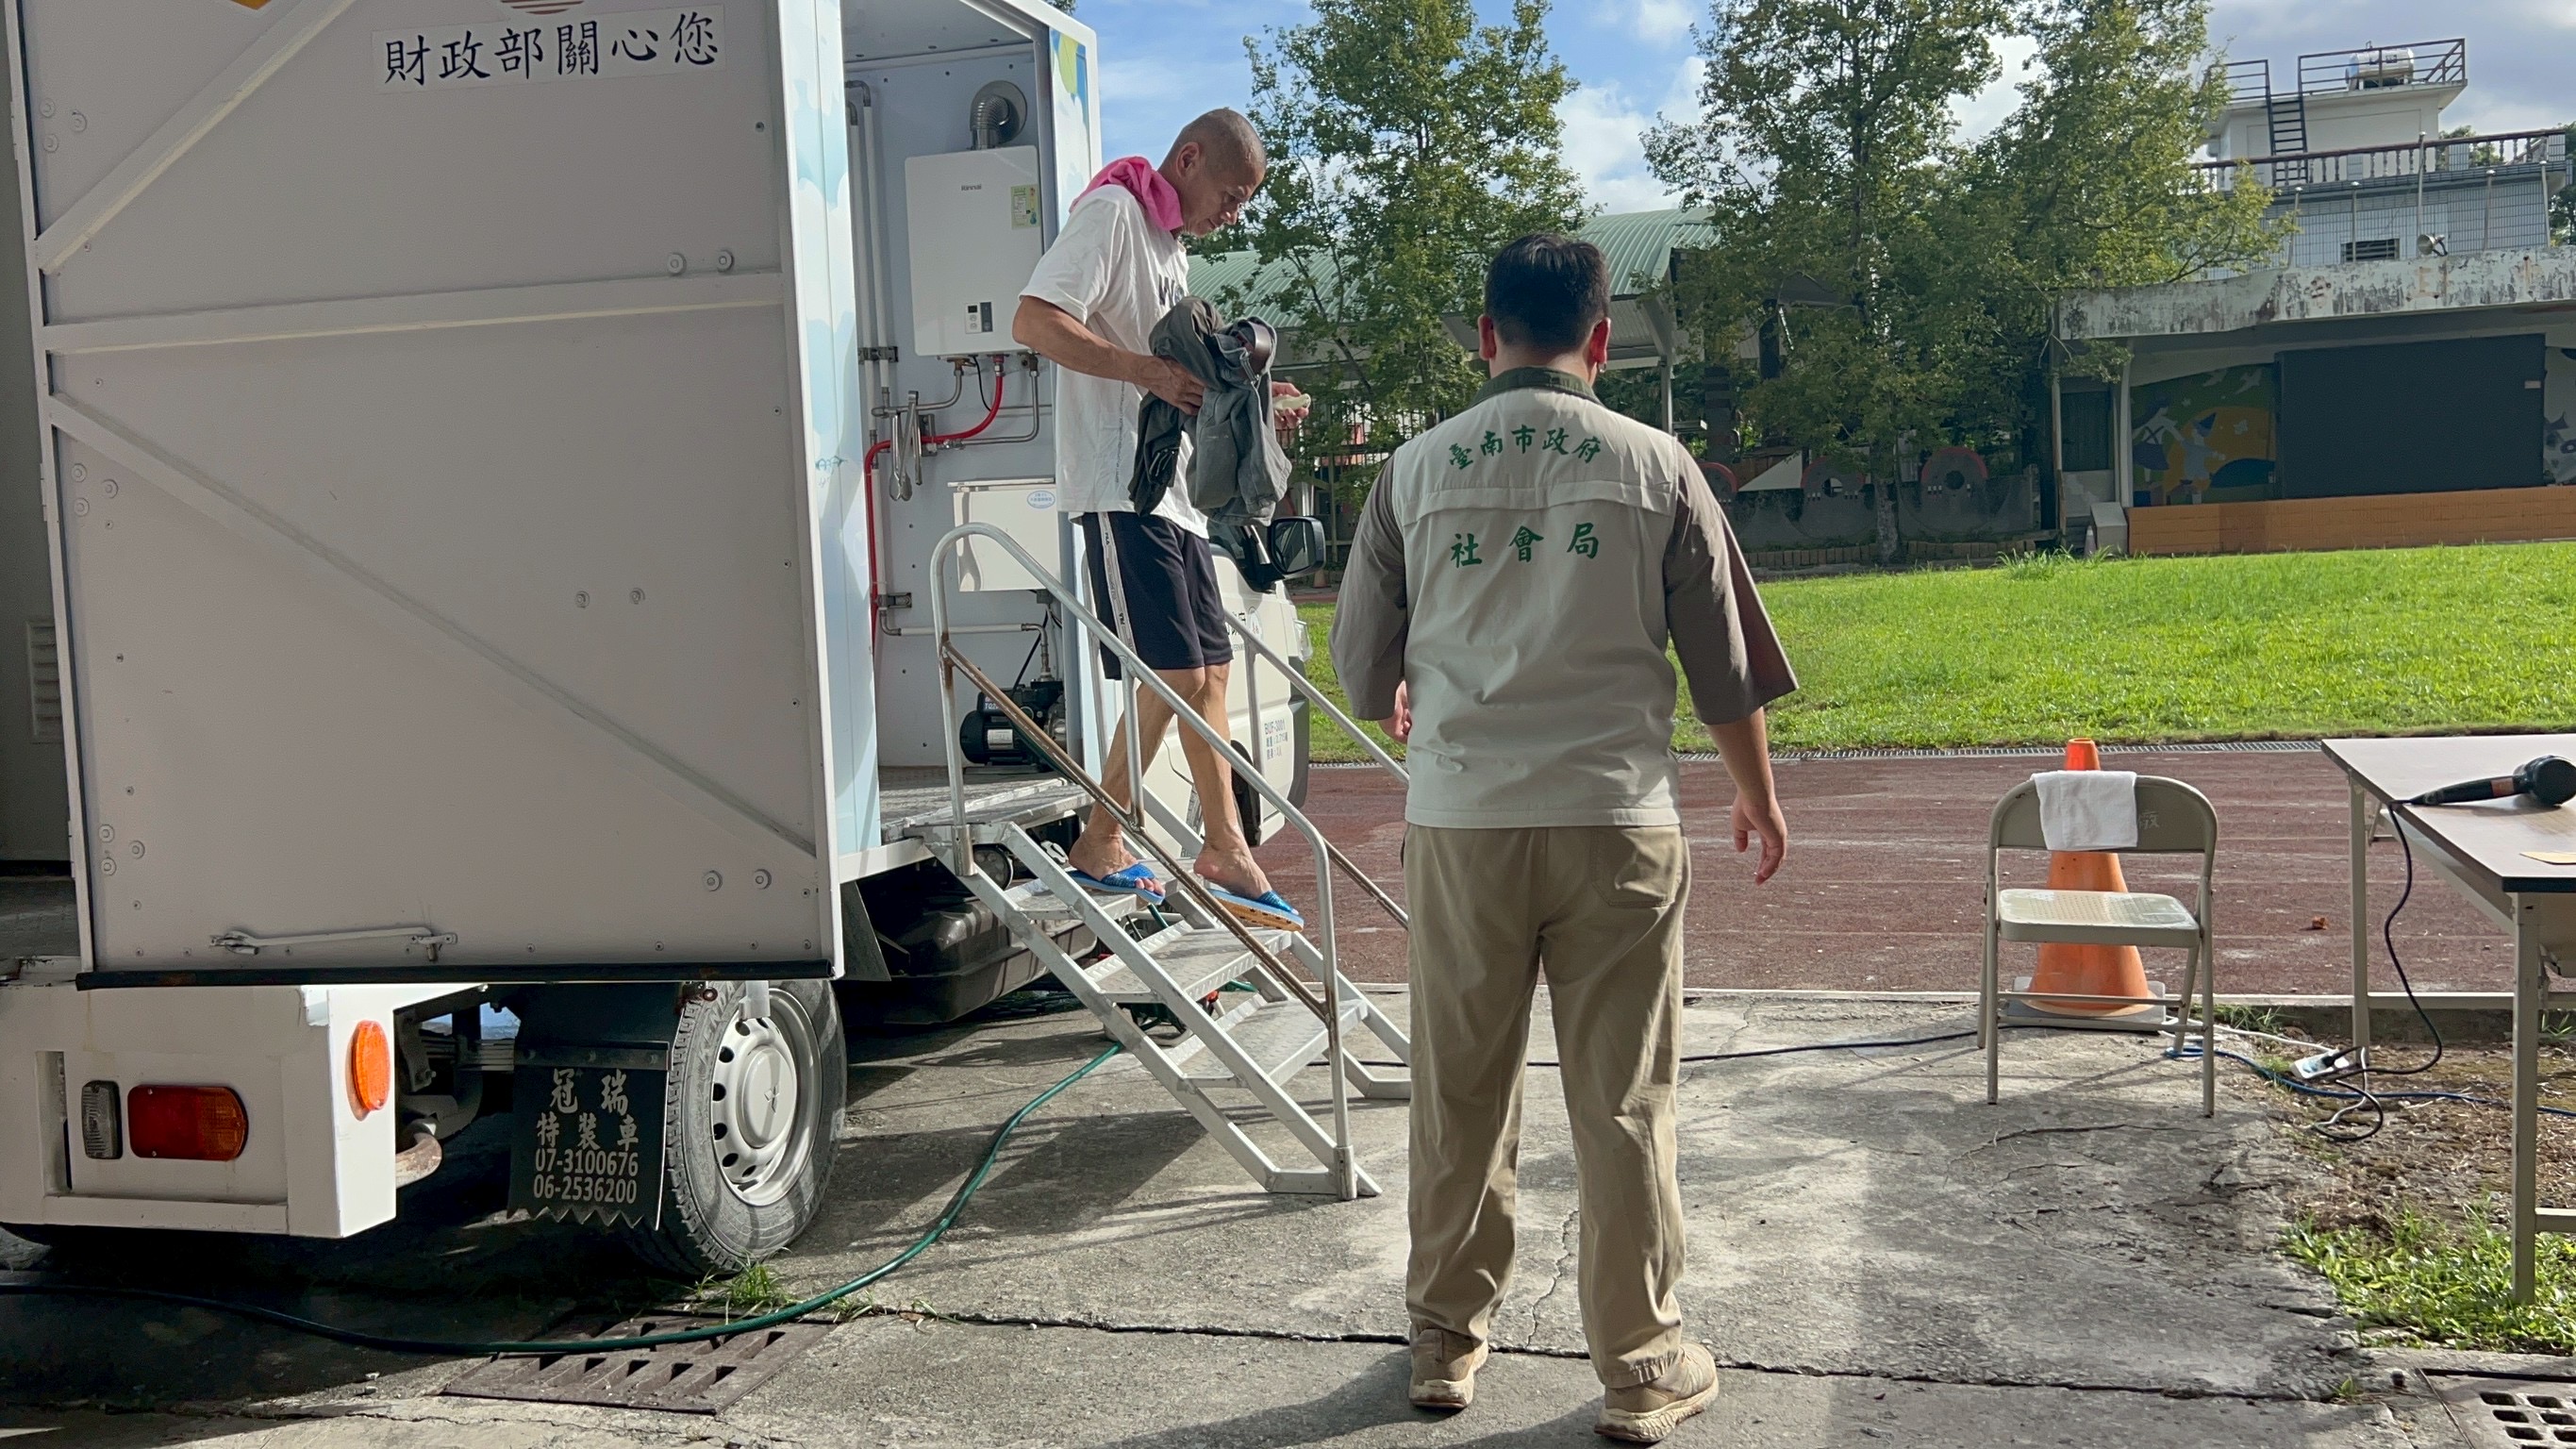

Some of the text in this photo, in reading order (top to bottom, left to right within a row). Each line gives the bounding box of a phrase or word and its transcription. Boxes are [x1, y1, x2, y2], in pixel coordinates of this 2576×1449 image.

[385, 11, 718, 86] 財政部關心您
[1449, 425, 1601, 470] 臺南市政府
[1451, 523, 1599, 568] 社會局
[549, 1068, 629, 1116] 冠瑞
[536, 1110, 639, 1151] 特裝車
[535, 1148, 639, 1176] 07-3100676
[533, 1174, 638, 1204] 06-2536200
